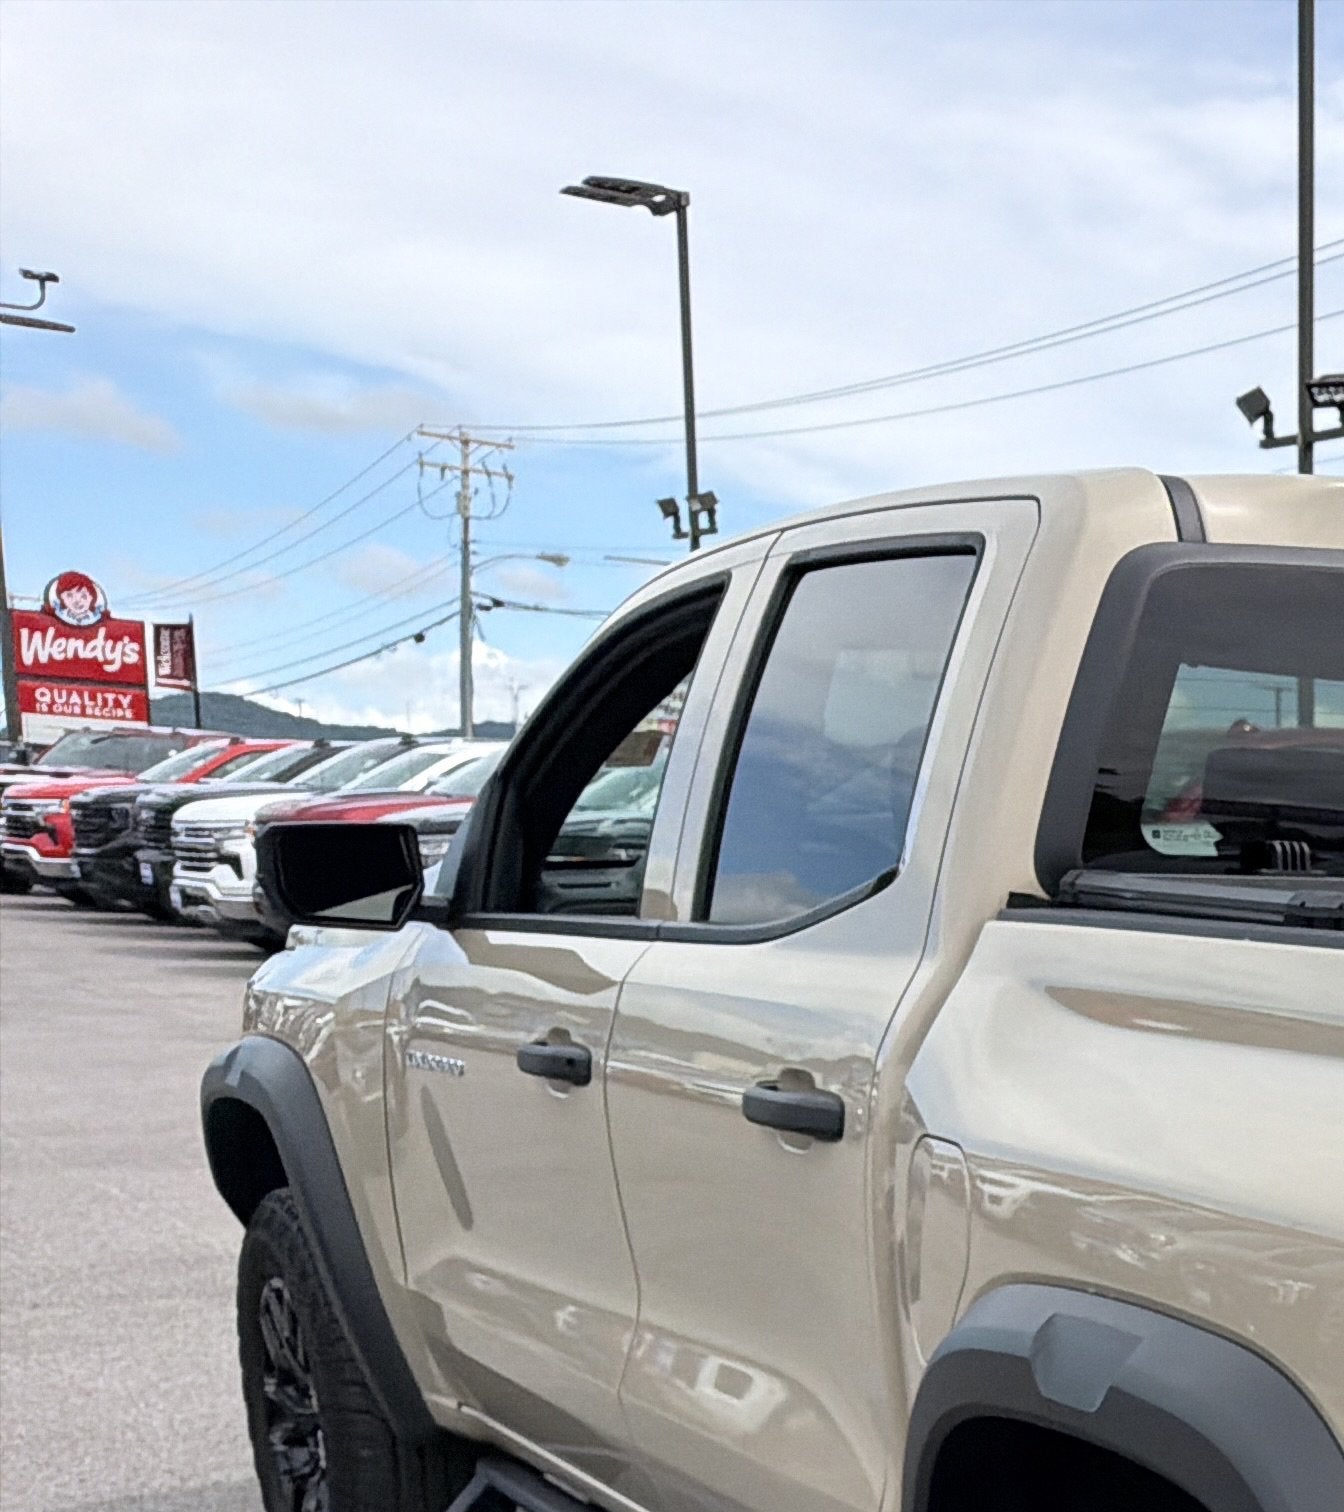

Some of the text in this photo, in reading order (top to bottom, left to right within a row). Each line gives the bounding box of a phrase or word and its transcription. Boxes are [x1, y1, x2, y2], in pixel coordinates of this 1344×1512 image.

[19, 626, 141, 673] Wendy's
[34, 686, 133, 709] QUALITY
[35, 702, 134, 719] IS OUR RECIPE
